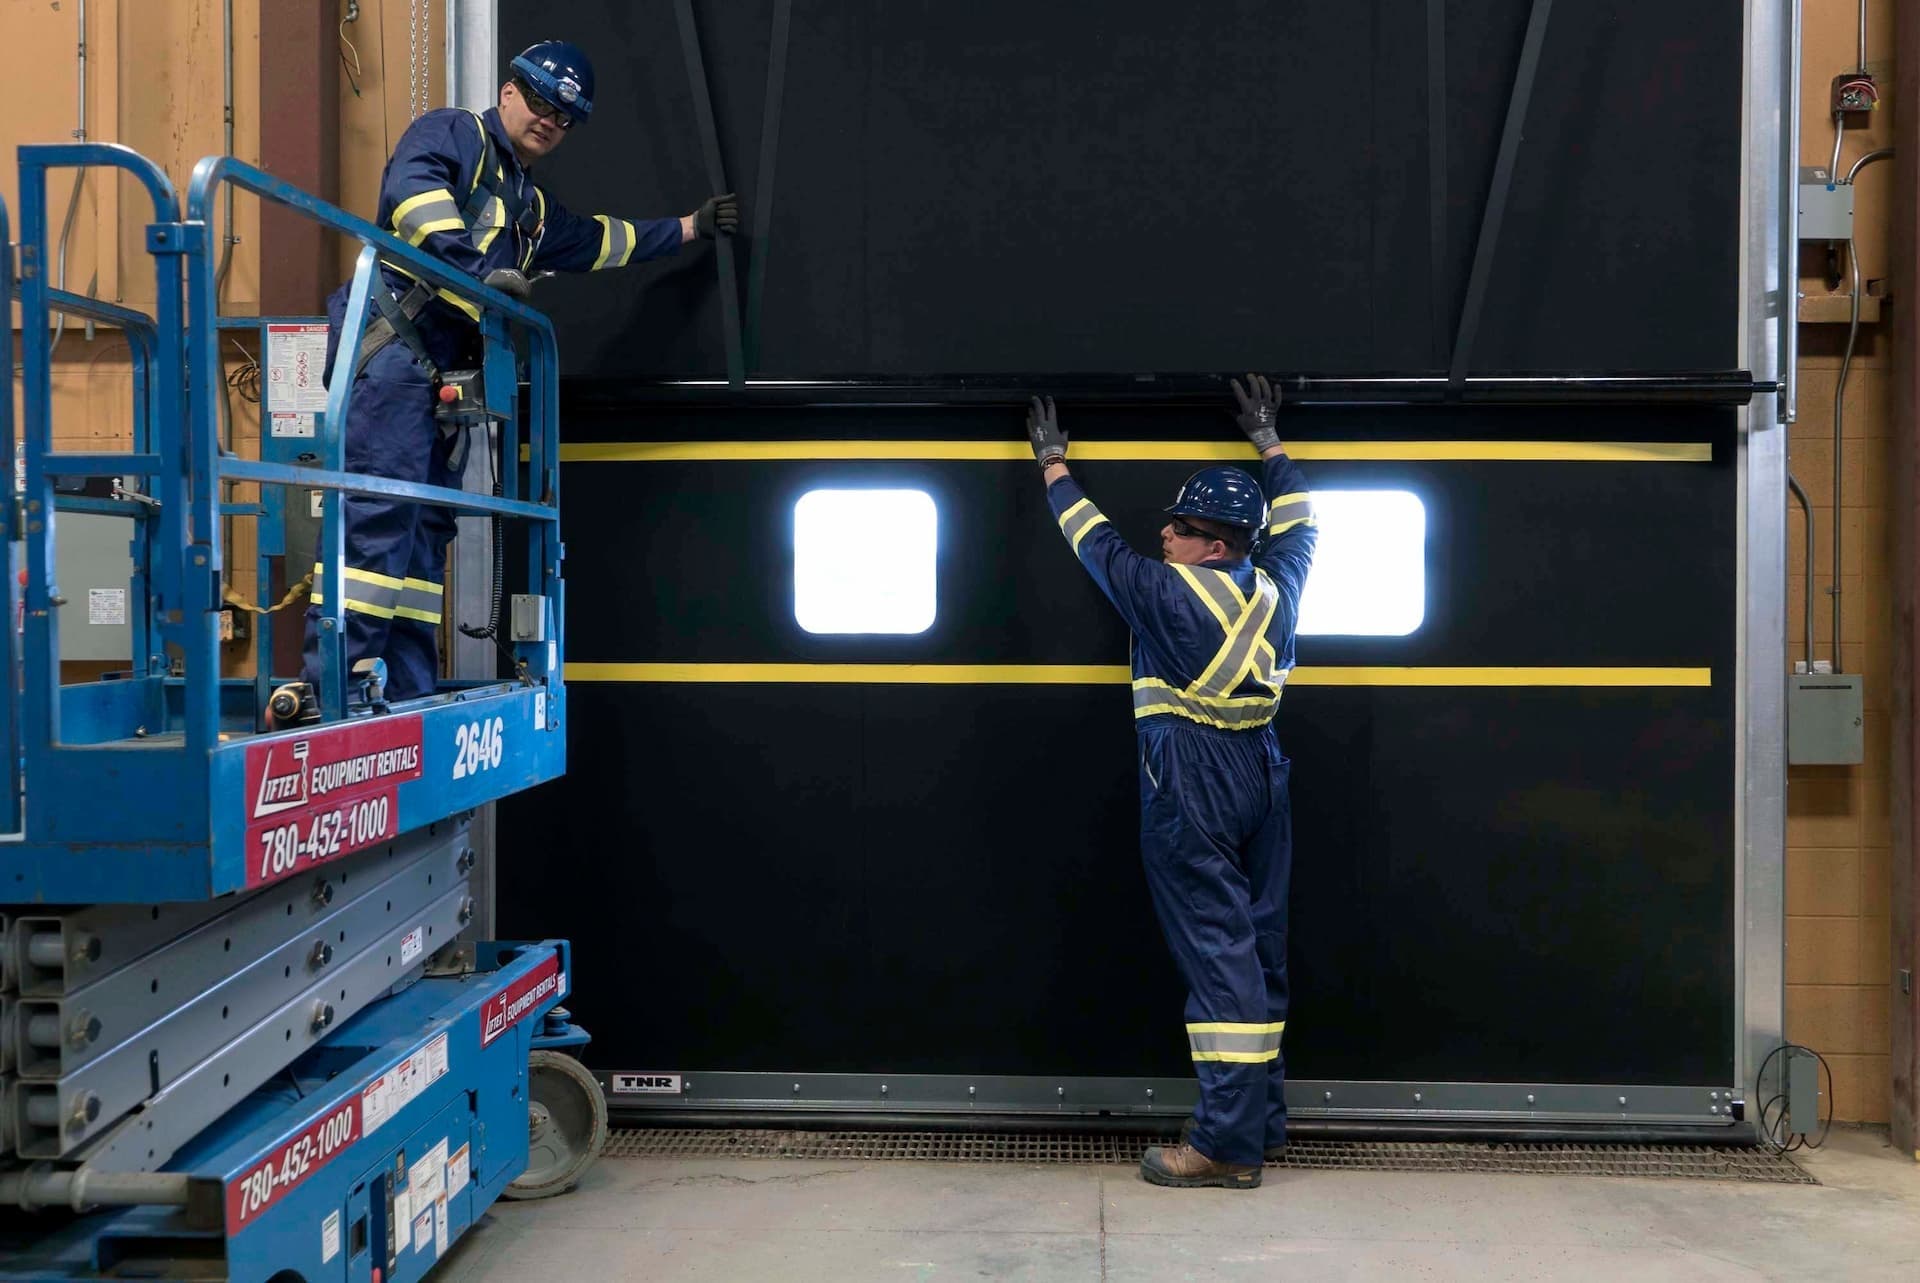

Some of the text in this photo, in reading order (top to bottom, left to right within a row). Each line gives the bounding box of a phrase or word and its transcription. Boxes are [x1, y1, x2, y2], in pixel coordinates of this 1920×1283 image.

[254, 745, 419, 818] LIFTEX EQUIPMENT RENTALS
[453, 716, 504, 780] 2646
[261, 796, 388, 879] 780-452-1000
[507, 987, 537, 1021] EQUIPMENT
[536, 973, 556, 1000] RENTALS
[621, 1077, 672, 1088] TNR
[240, 1105, 353, 1220] 780-452-1000
